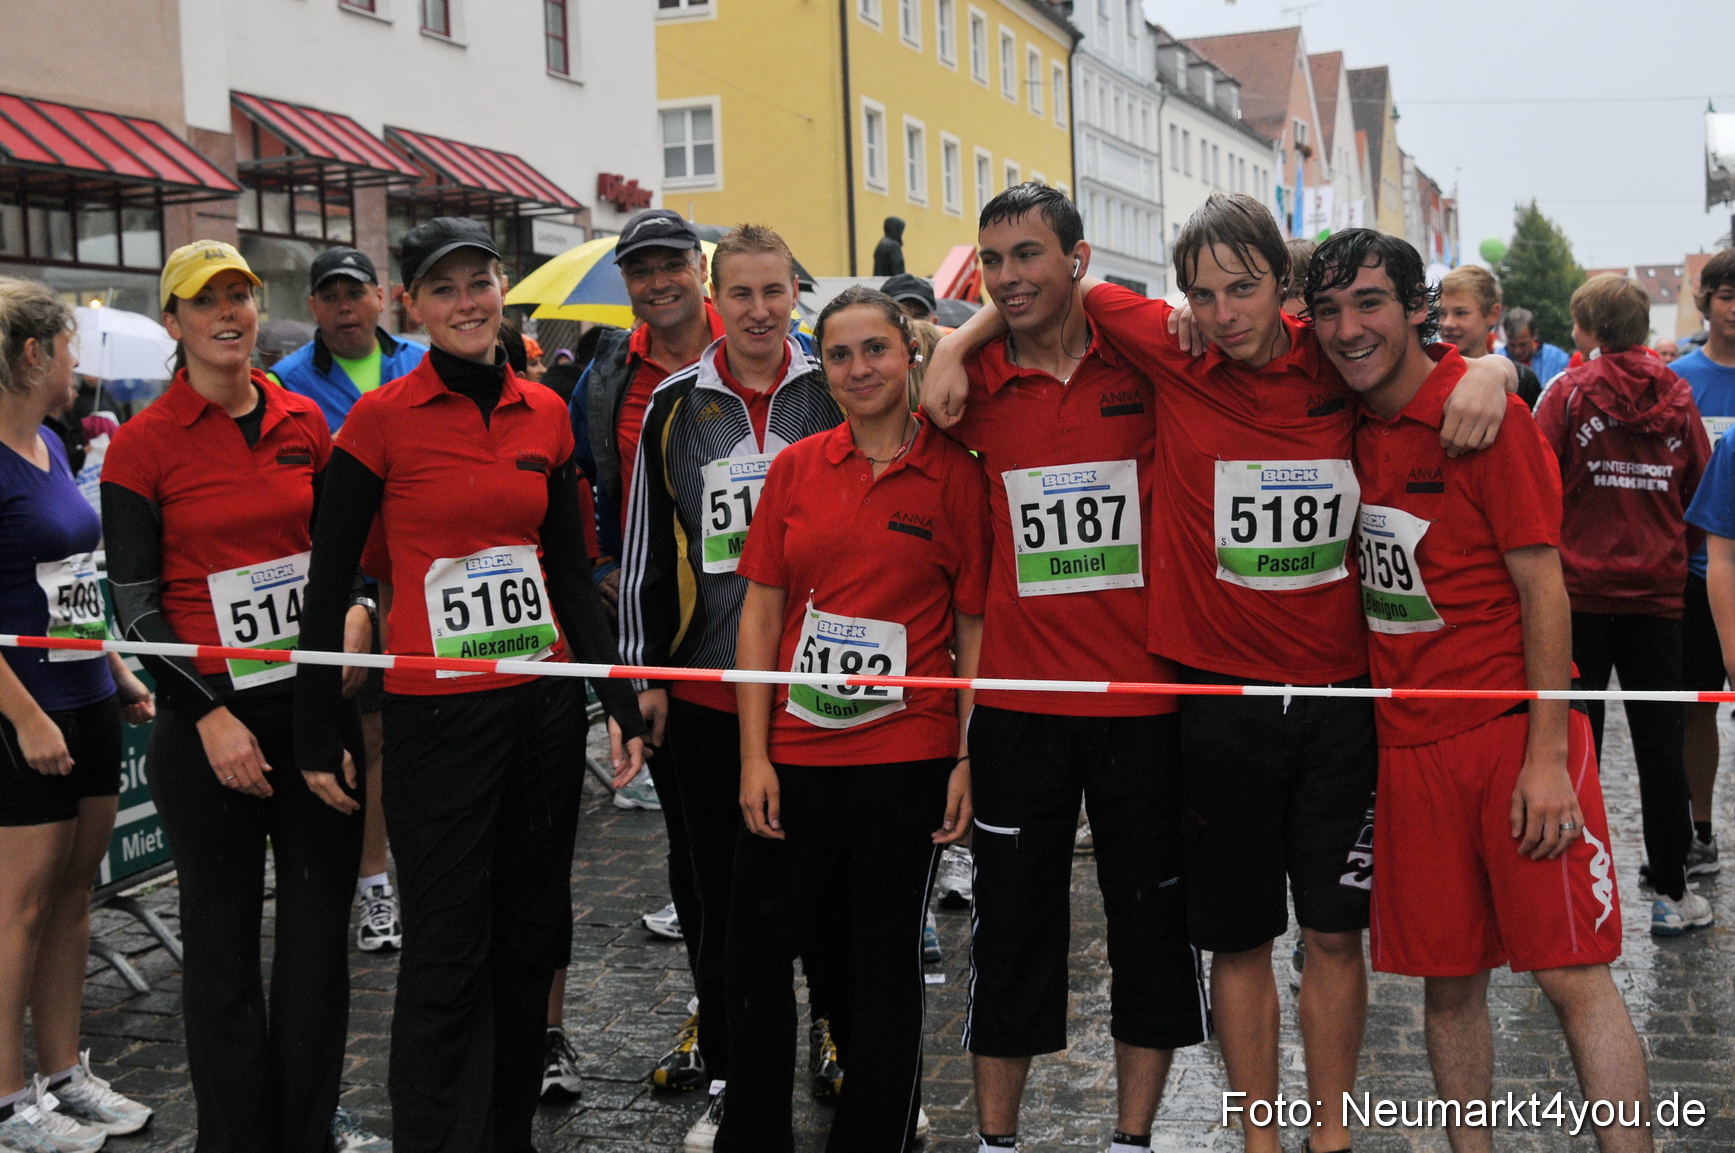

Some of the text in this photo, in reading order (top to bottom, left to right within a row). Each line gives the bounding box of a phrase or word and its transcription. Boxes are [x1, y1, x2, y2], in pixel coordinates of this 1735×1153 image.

[1100, 389, 1143, 405] ANNA
[1576, 415, 1605, 447] JFG
[1042, 471, 1096, 487] BOCK
[1261, 469, 1318, 482] BOCK
[1408, 468, 1444, 481] ANNA
[1602, 460, 1674, 477] INTERSPORT
[710, 485, 764, 531] 51
[1230, 494, 1342, 543] 5181
[890, 511, 934, 531] ANNA
[1020, 495, 1127, 549] 5187
[466, 554, 513, 571] BOCK
[1050, 553, 1106, 576] Daniel
[1257, 552, 1315, 572] Pascal
[251, 564, 294, 584] BOCK
[442, 577, 542, 631] 5169
[1366, 593, 1408, 621] Benigno
[230, 588, 302, 643] 514
[817, 620, 866, 638] BOCK
[461, 634, 539, 659] Alexandra
[800, 635, 892, 697] 5182
[816, 695, 859, 716] Leoni
[122, 826, 165, 862] Miet
